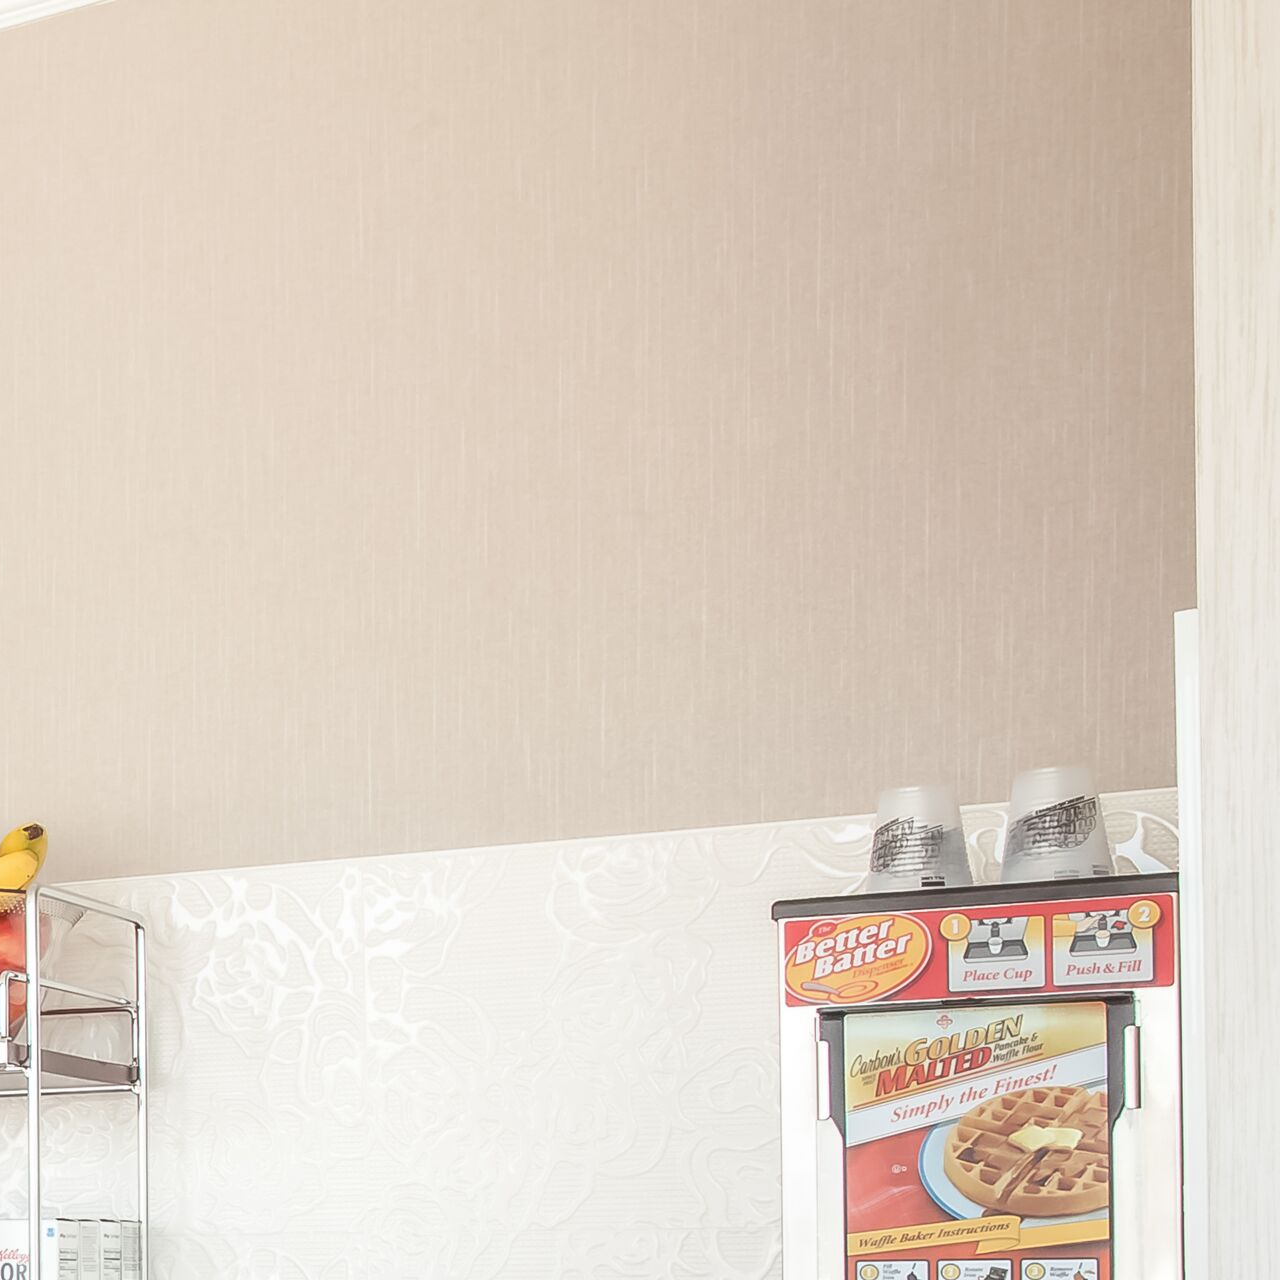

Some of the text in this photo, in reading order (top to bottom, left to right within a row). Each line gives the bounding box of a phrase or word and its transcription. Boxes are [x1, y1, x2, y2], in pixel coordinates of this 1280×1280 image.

[1138, 906, 1151, 922] 2
[818, 925, 832, 934] The
[951, 919, 960, 934] 1
[794, 918, 894, 965] Better
[813, 933, 912, 979] Batter
[852, 958, 905, 978] Dispenser
[963, 967, 1033, 982] Place Cup
[1066, 960, 1142, 976] Push & Fill
[903, 1014, 1023, 1067] GOLDEN
[994, 1032, 1039, 1053] Pancake &
[992, 1049, 1020, 1064] Waffle
[875, 1047, 992, 1097] MALTED
[891, 1064, 1058, 1123] Simply the Finest!
[858, 1222, 1010, 1249] Waffle Baker Instructions
